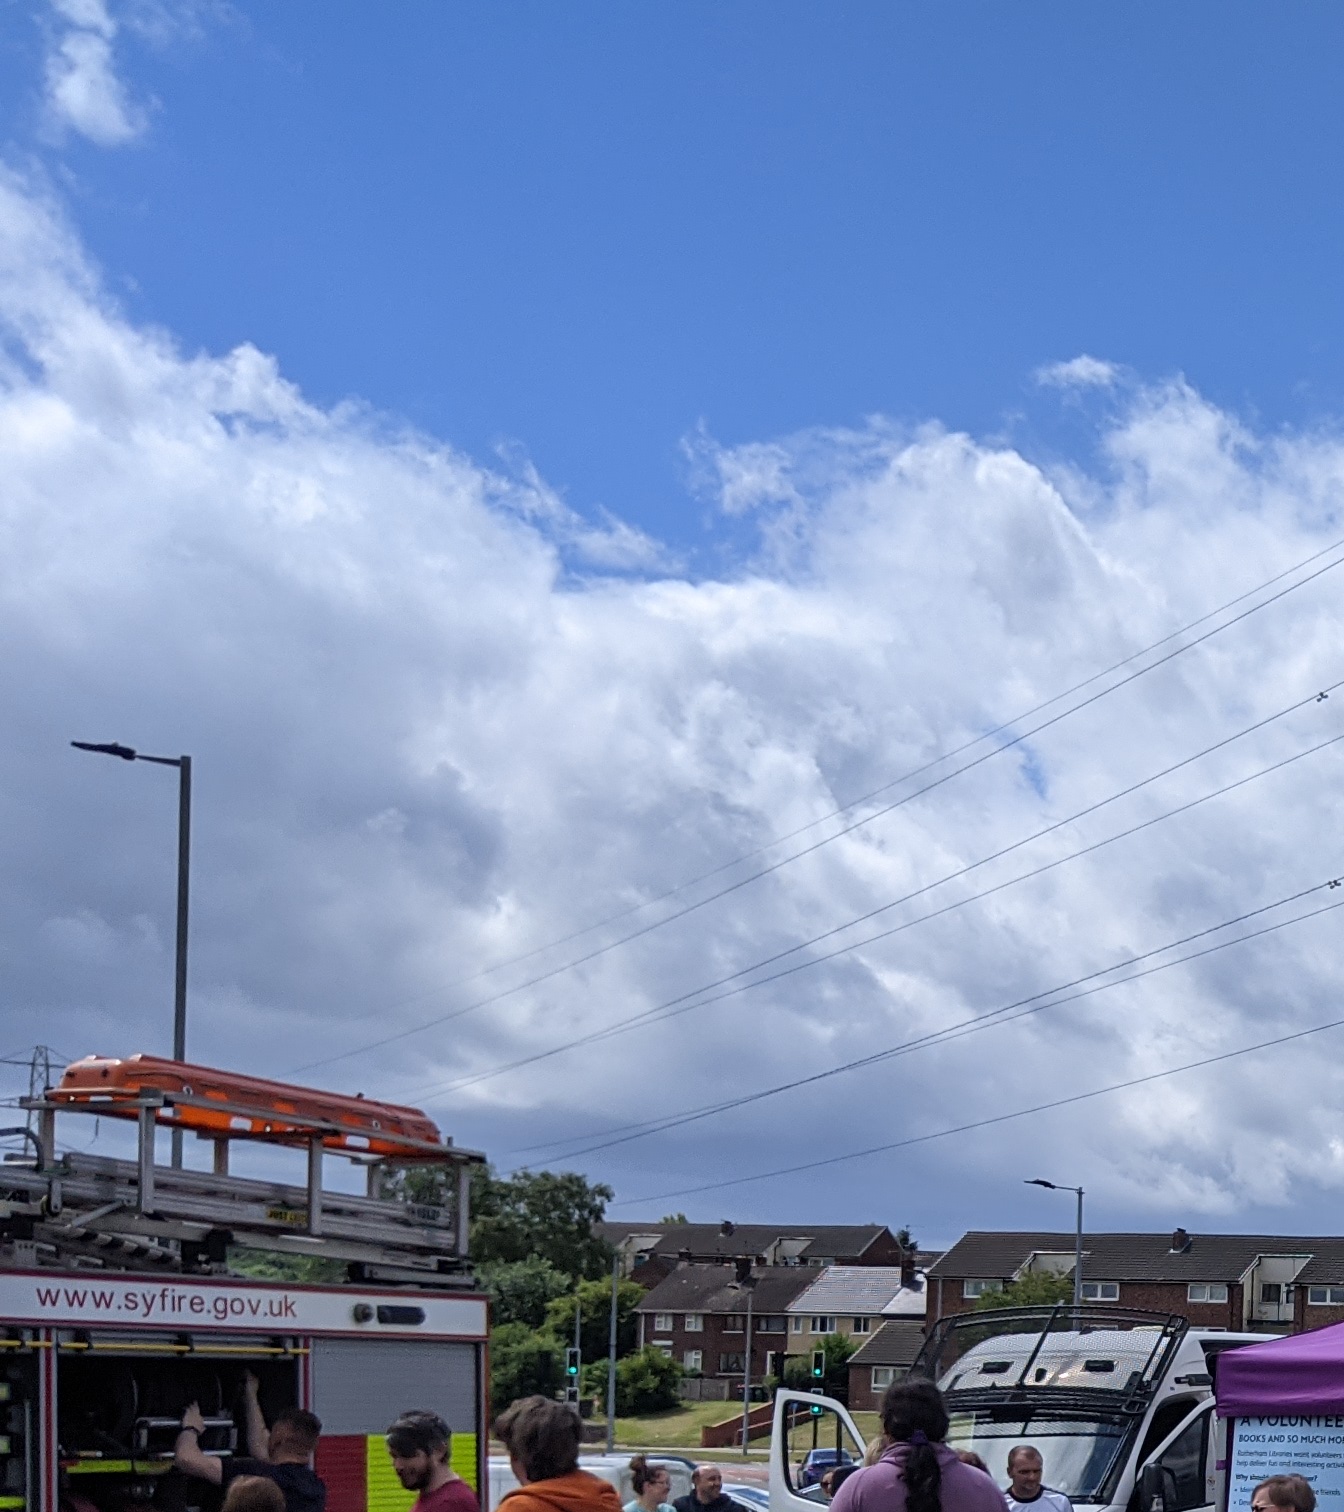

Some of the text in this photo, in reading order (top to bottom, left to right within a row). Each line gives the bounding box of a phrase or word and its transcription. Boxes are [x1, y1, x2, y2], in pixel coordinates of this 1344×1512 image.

[36, 1287, 297, 1321] www.syfire.gov.uk
[1239, 1434, 1266, 1443] BOOKS
[1268, 1435, 1286, 1443] AND
[1287, 1435, 1299, 1443] SO
[1300, 1435, 1326, 1444] MUCH
